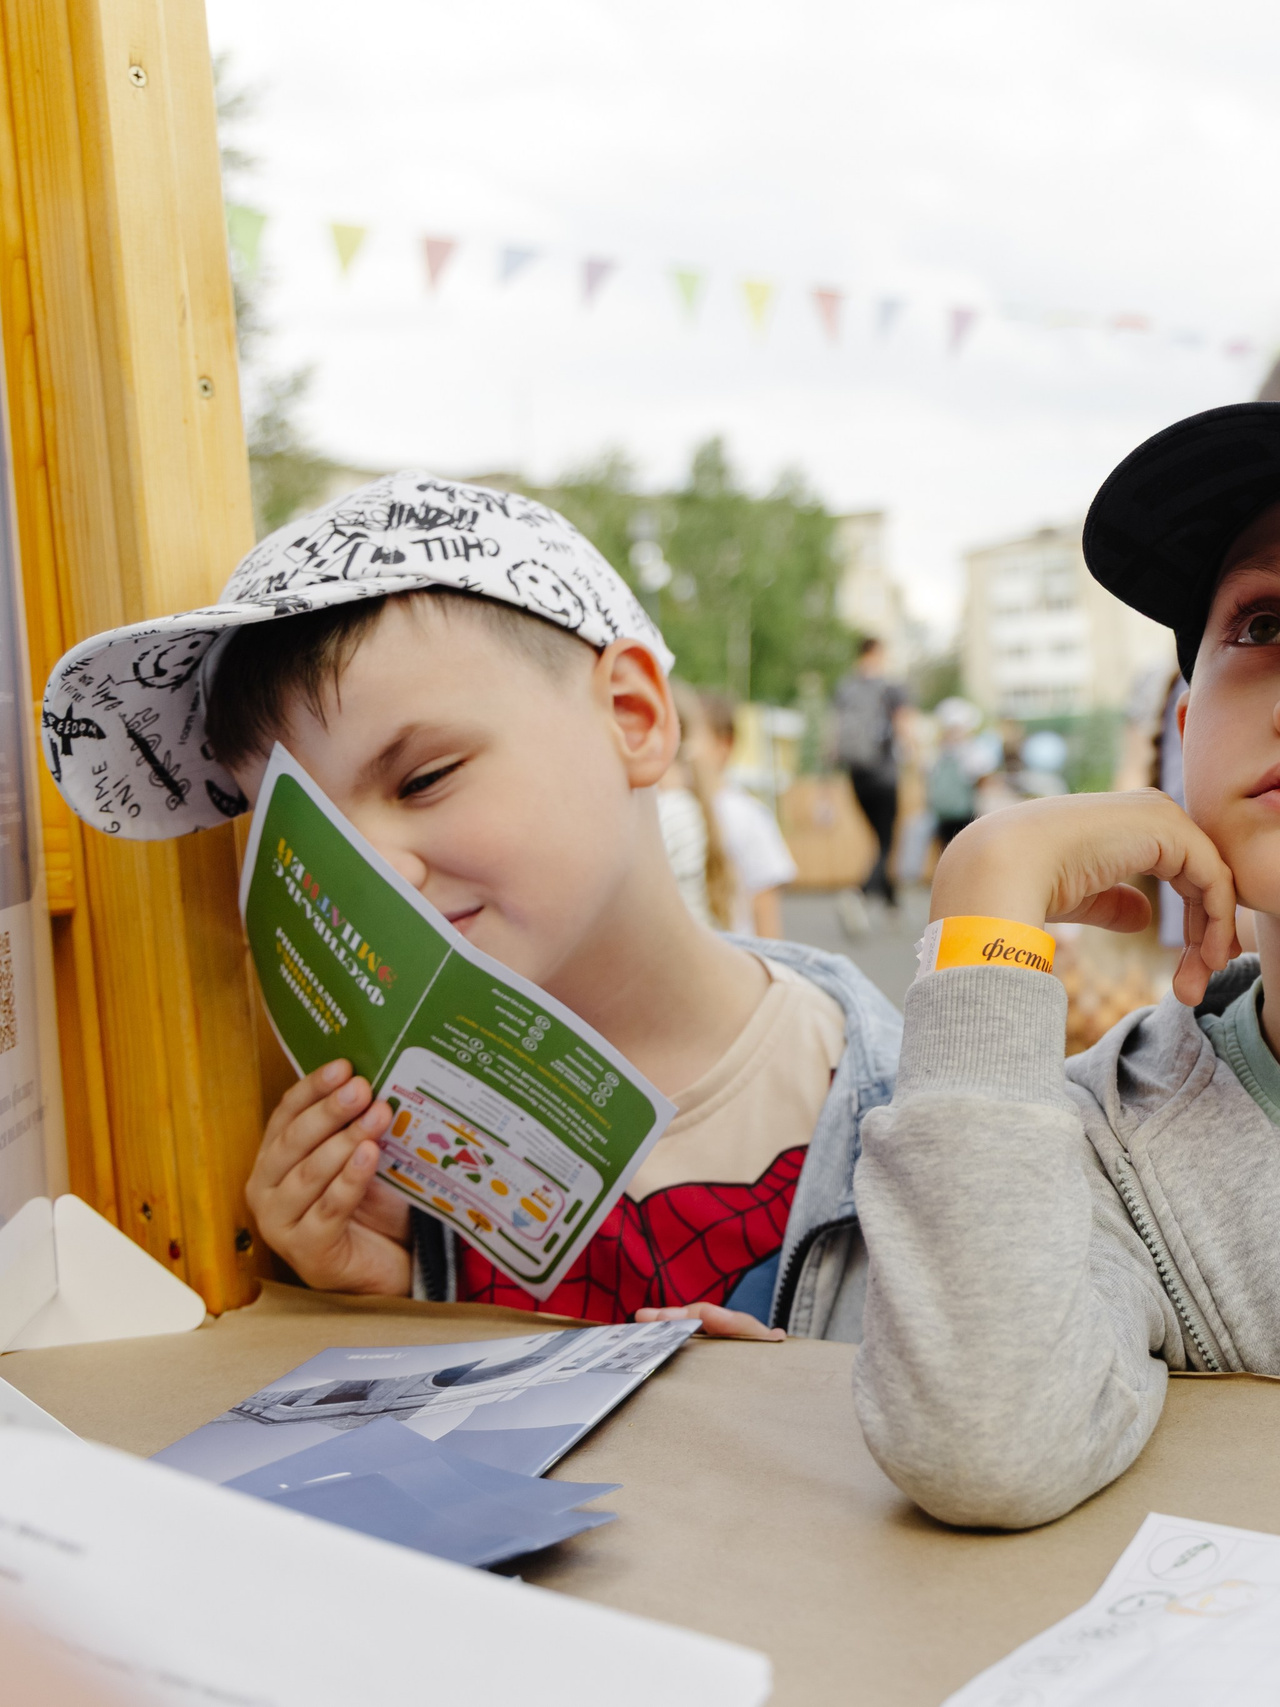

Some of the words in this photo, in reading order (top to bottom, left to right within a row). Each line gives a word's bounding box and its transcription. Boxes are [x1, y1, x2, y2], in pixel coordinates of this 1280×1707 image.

[410, 535, 500, 562] CHILL
[92, 760, 121, 834] GAME
[278, 837, 397, 989] ЭМПАТИЕЙ
[285, 876, 385, 1007] ФЕСТИВАЛЬ
[276, 926, 348, 1028] ВИКТОРИНЫ
[279, 963, 334, 1036] ДНЕВНИК
